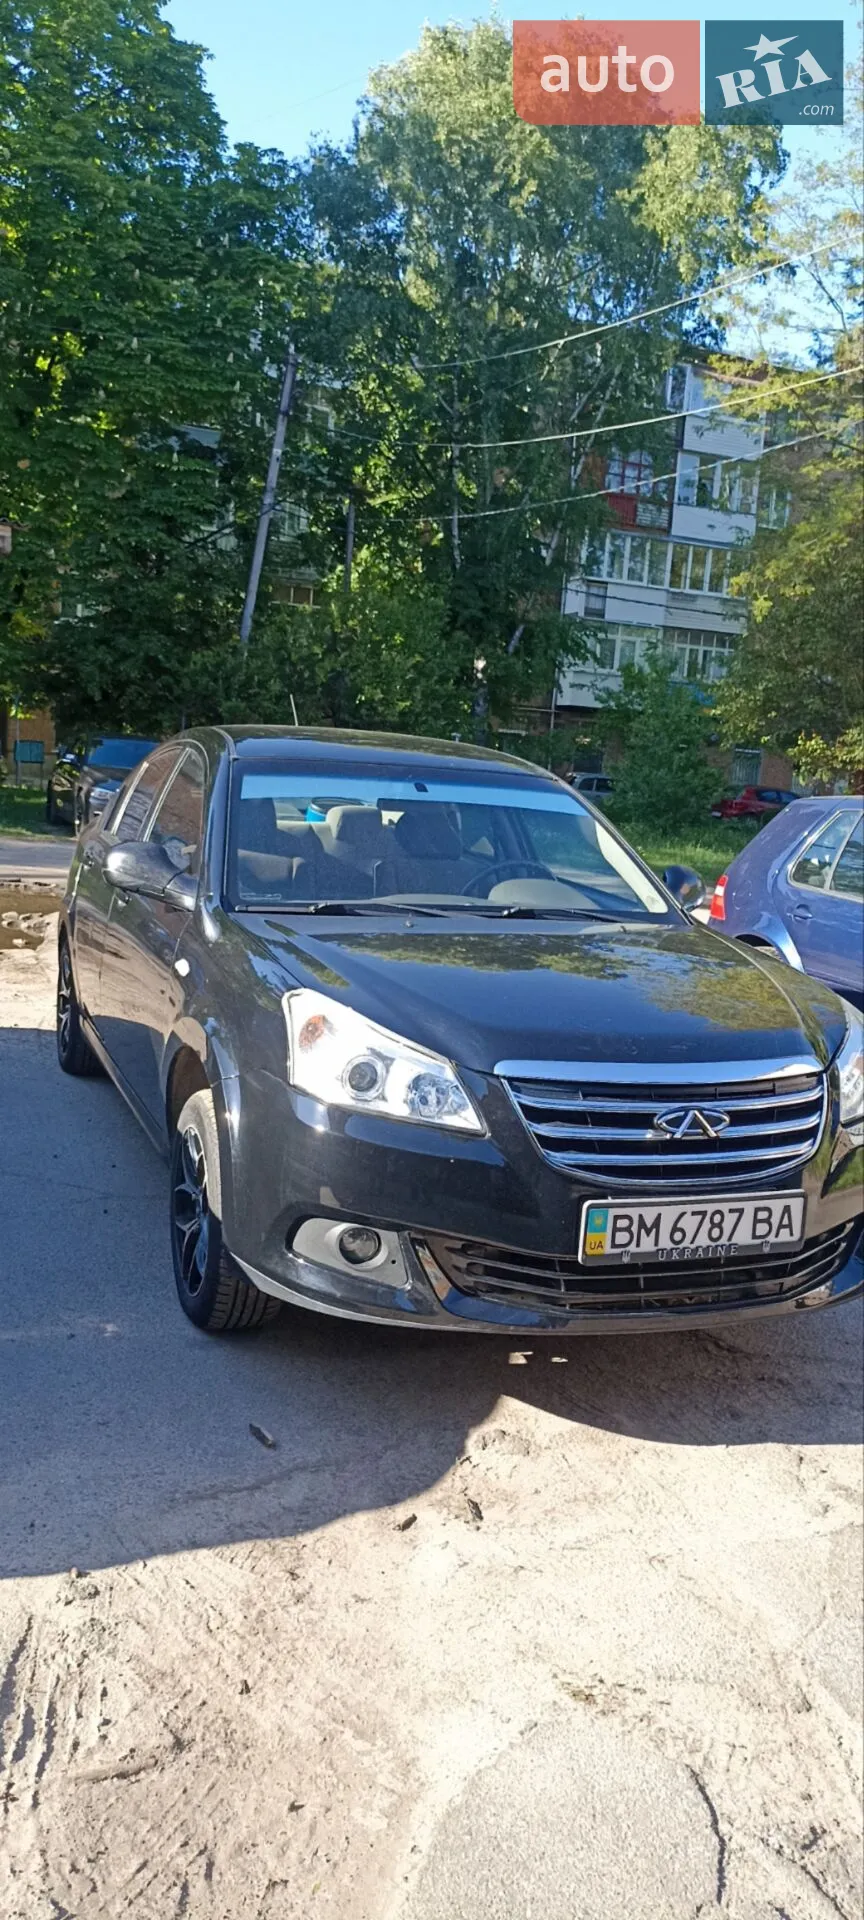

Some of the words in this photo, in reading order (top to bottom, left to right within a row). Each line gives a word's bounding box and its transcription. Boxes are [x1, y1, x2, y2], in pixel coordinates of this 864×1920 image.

[610, 1213, 662, 1249] BM
[669, 1208, 745, 1246] 6787
[751, 1204, 794, 1240] BA
[589, 1240, 604, 1250] UA
[658, 1245, 739, 1261] UKRAINE
